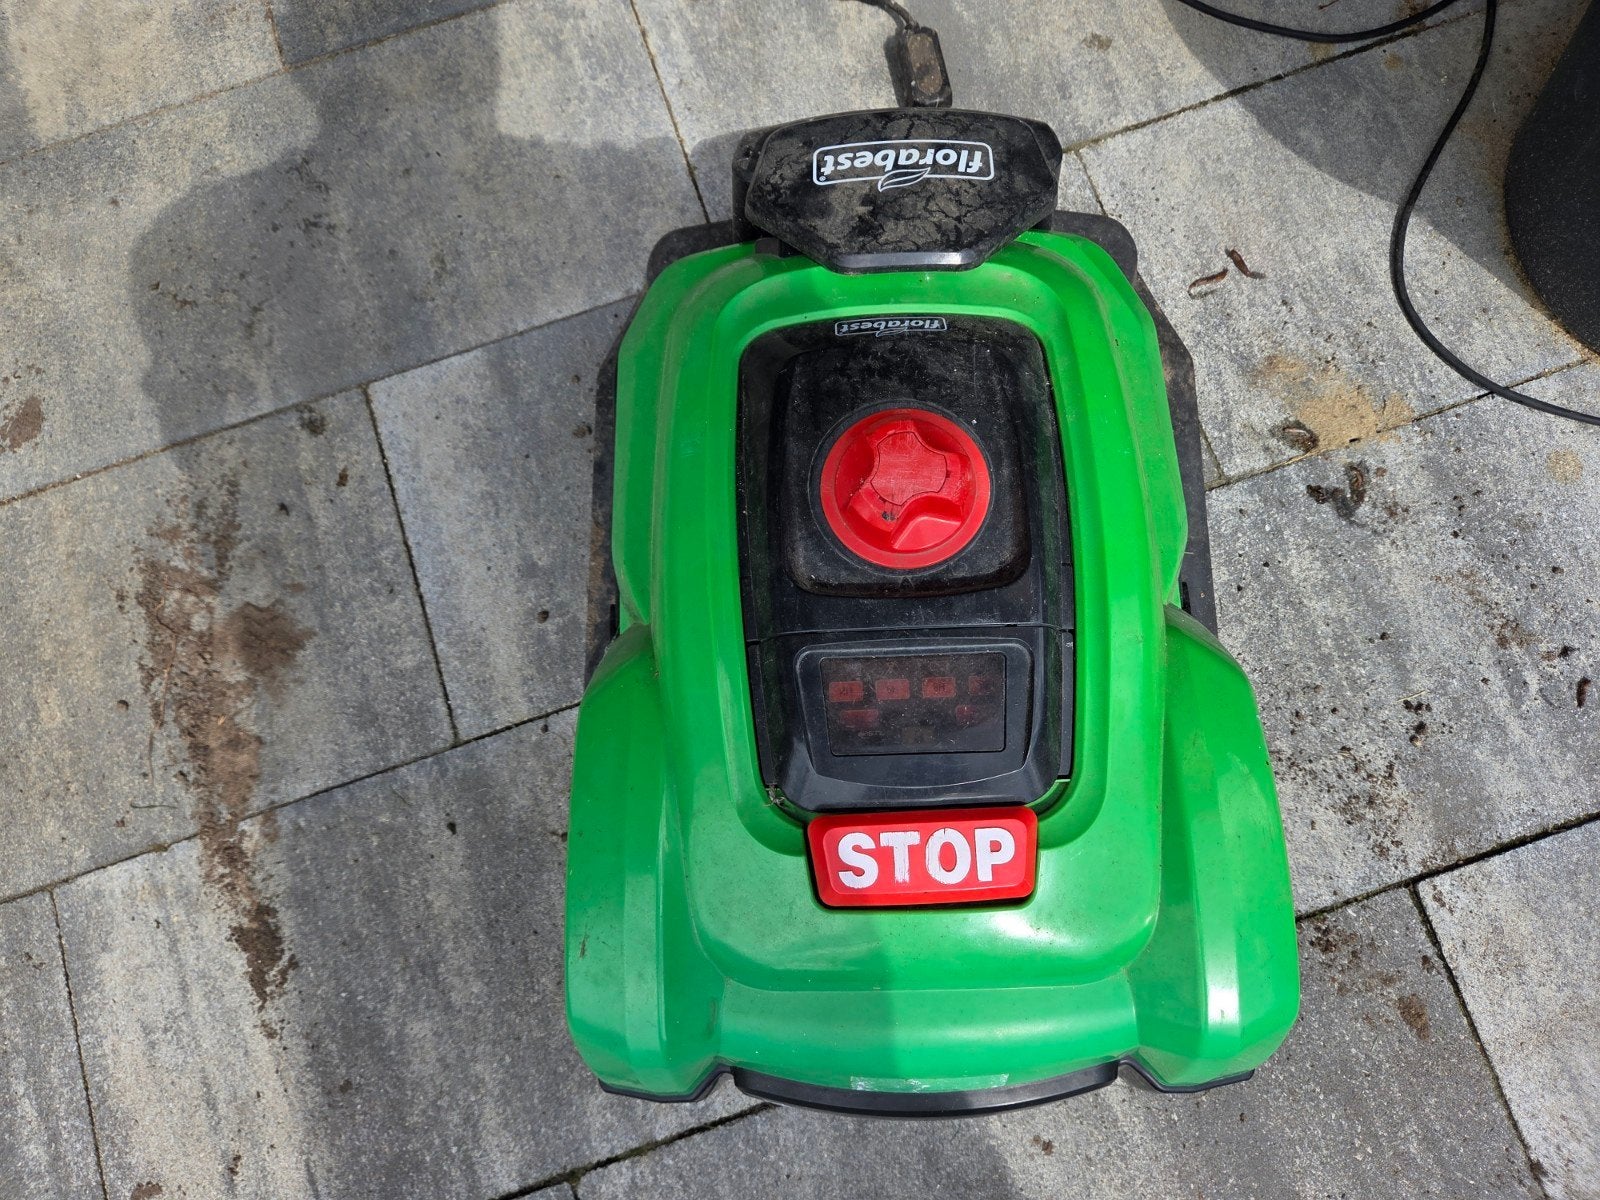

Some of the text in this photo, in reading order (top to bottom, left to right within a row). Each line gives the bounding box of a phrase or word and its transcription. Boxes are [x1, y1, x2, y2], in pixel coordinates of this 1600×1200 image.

[821, 148, 983, 176] florabest
[840, 319, 941, 332] florabest
[837, 827, 1016, 889] STOP
